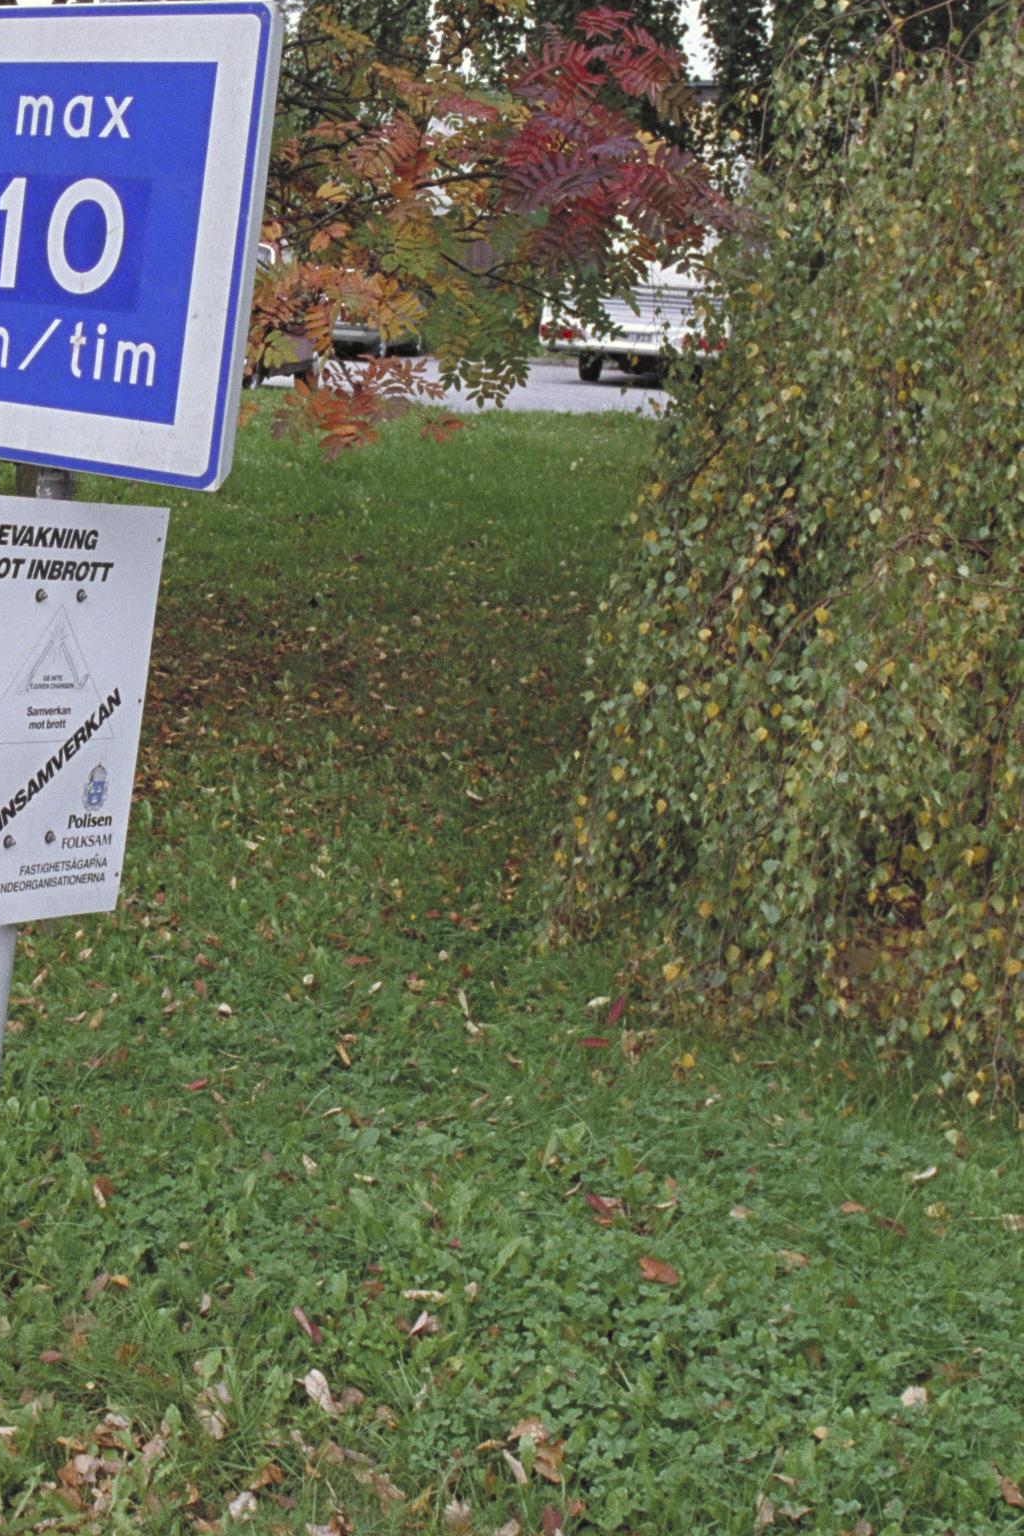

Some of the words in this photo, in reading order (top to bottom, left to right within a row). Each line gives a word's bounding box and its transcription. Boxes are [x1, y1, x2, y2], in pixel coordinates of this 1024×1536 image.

[15, 94, 133, 139] max
[27, 559, 114, 582] INBROTT
[27, 706, 71, 717] Samverkan
[28, 720, 46, 730] mot
[46, 719, 66, 730] brott
[68, 813, 113, 829] Polisen
[61, 834, 112, 850] FOLKSAM
